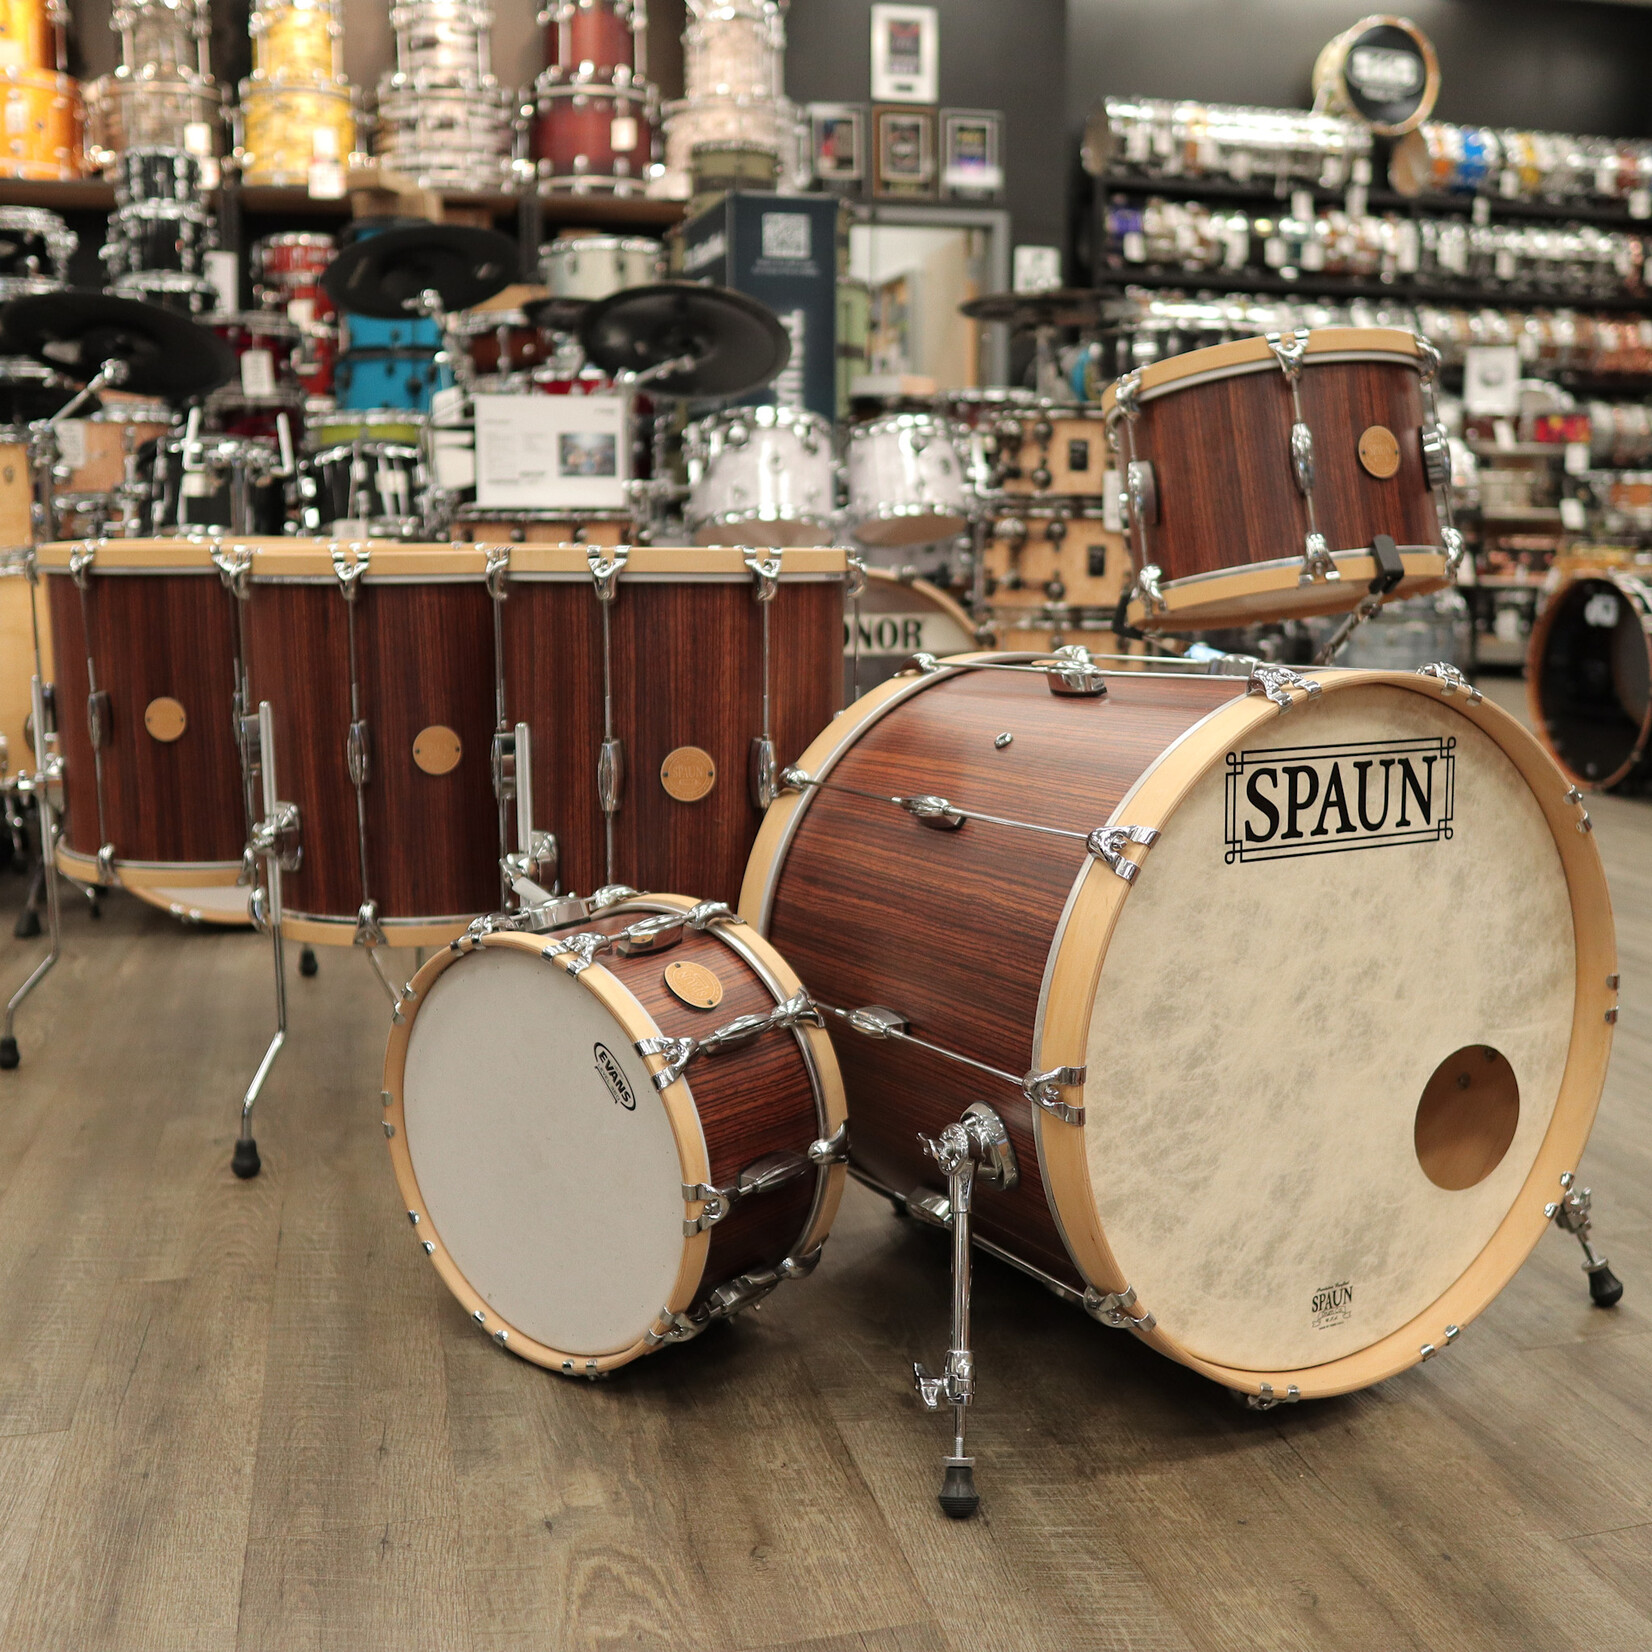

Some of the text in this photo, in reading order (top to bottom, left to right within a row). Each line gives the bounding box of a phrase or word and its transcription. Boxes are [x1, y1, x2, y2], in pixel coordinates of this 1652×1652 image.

[1244, 755, 1438, 843] SPAUN
[598, 1050, 631, 1102] EVANS
[1312, 1286, 1353, 1313] SPAUN
